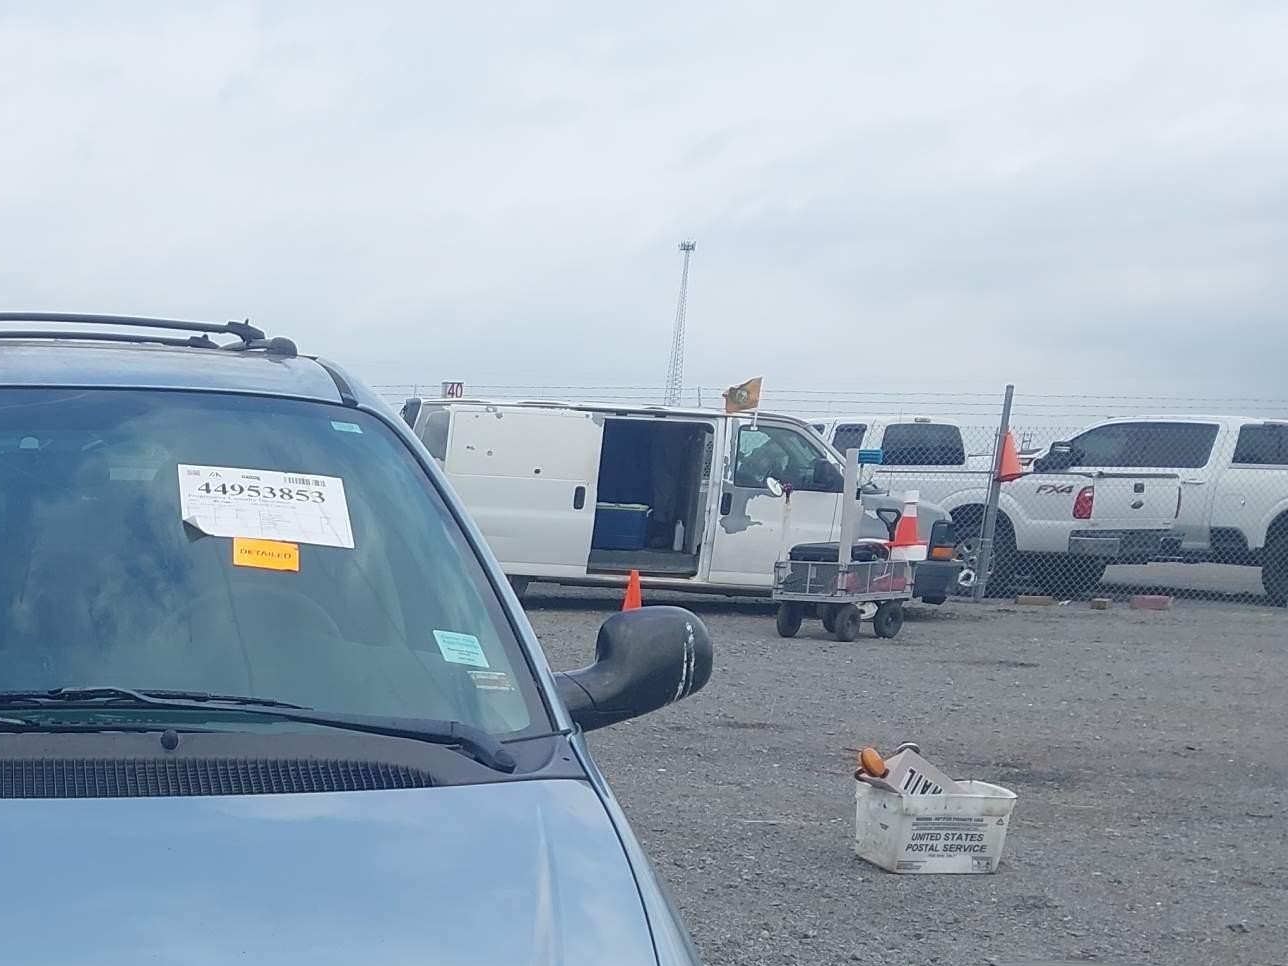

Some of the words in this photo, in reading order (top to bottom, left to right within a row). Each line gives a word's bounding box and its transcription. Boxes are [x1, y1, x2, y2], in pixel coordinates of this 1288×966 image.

[447, 383, 463, 398] 40
[198, 482, 326, 504] 44953853
[1036, 484, 1074, 495] FX4
[239, 547, 292, 560] DETAILED
[911, 832, 942, 841] UNITED
[943, 833, 985, 842] STATES
[905, 843, 940, 853] POSTAL
[942, 844, 988, 853] SERVICE
